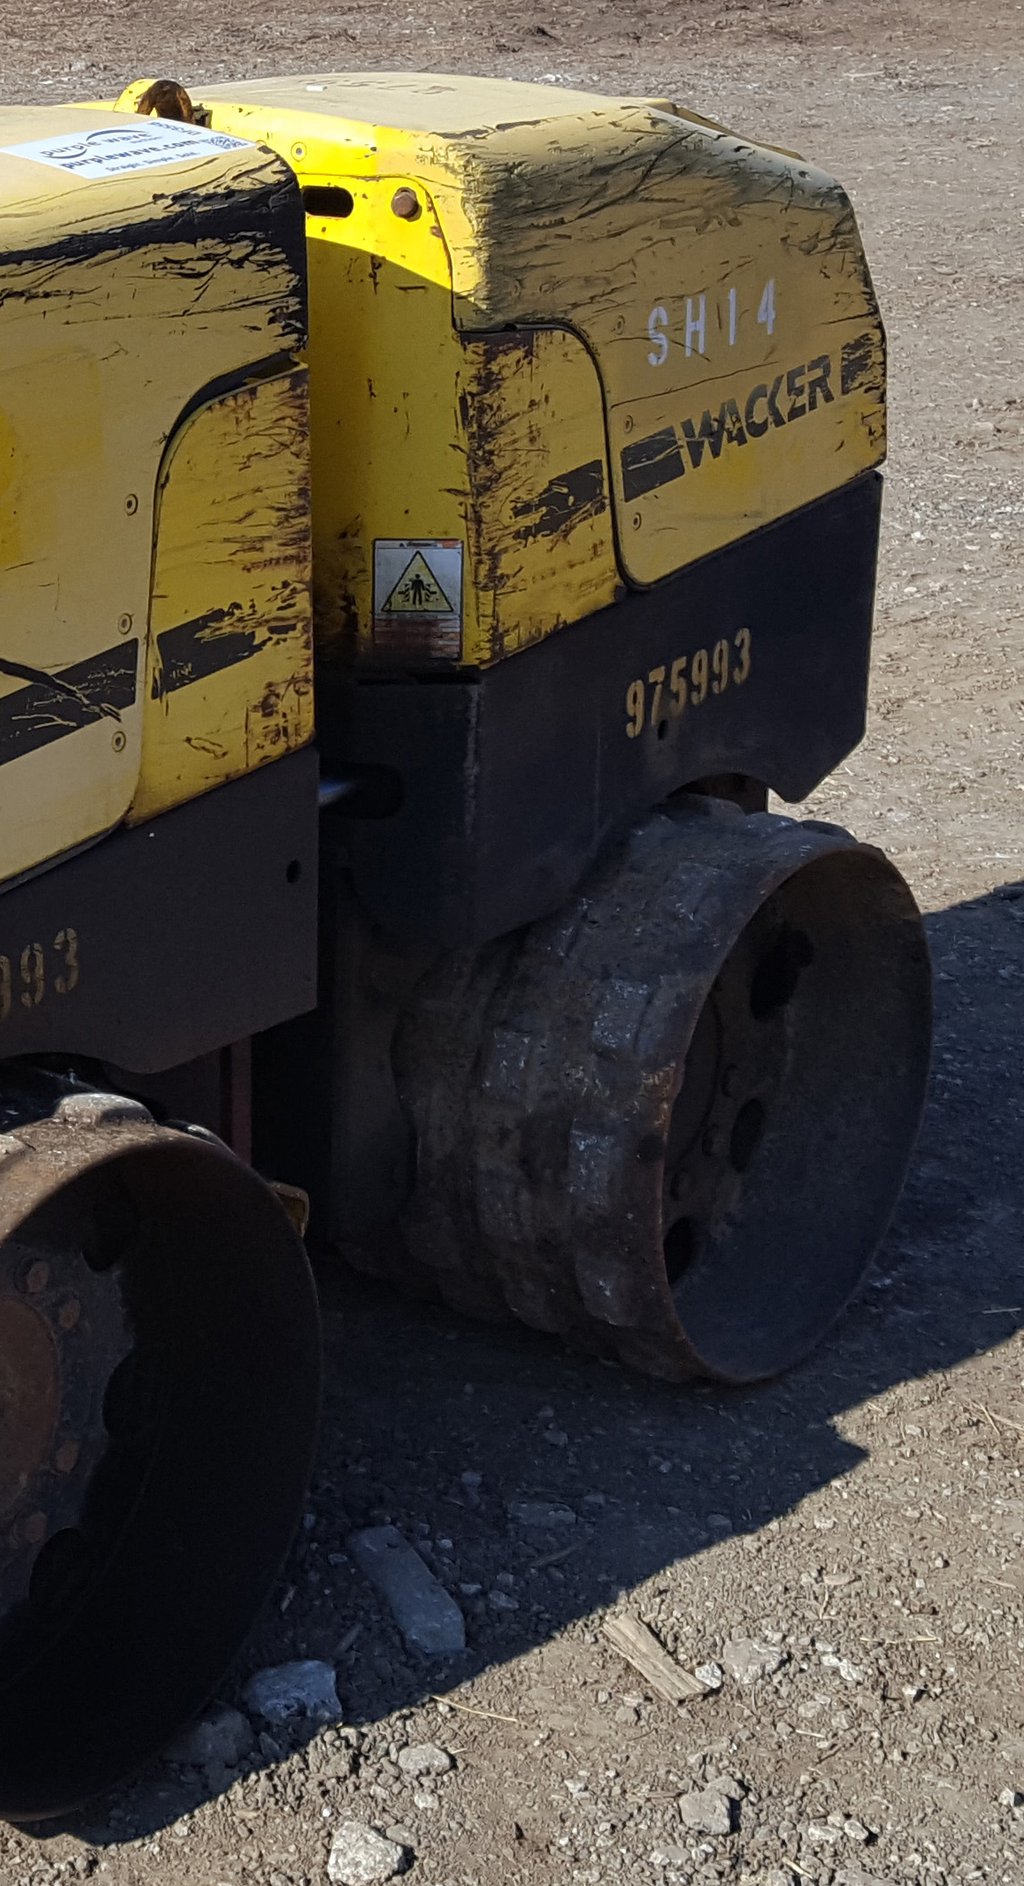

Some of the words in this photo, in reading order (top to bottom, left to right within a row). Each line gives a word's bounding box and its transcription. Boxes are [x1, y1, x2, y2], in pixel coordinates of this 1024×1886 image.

[40, 142, 102, 157] purple
[101, 133, 152, 144] wave
[59, 140, 200, 170] purplewave.com
[680, 354, 834, 469] WACKER
[626, 627, 752, 738] 975993
